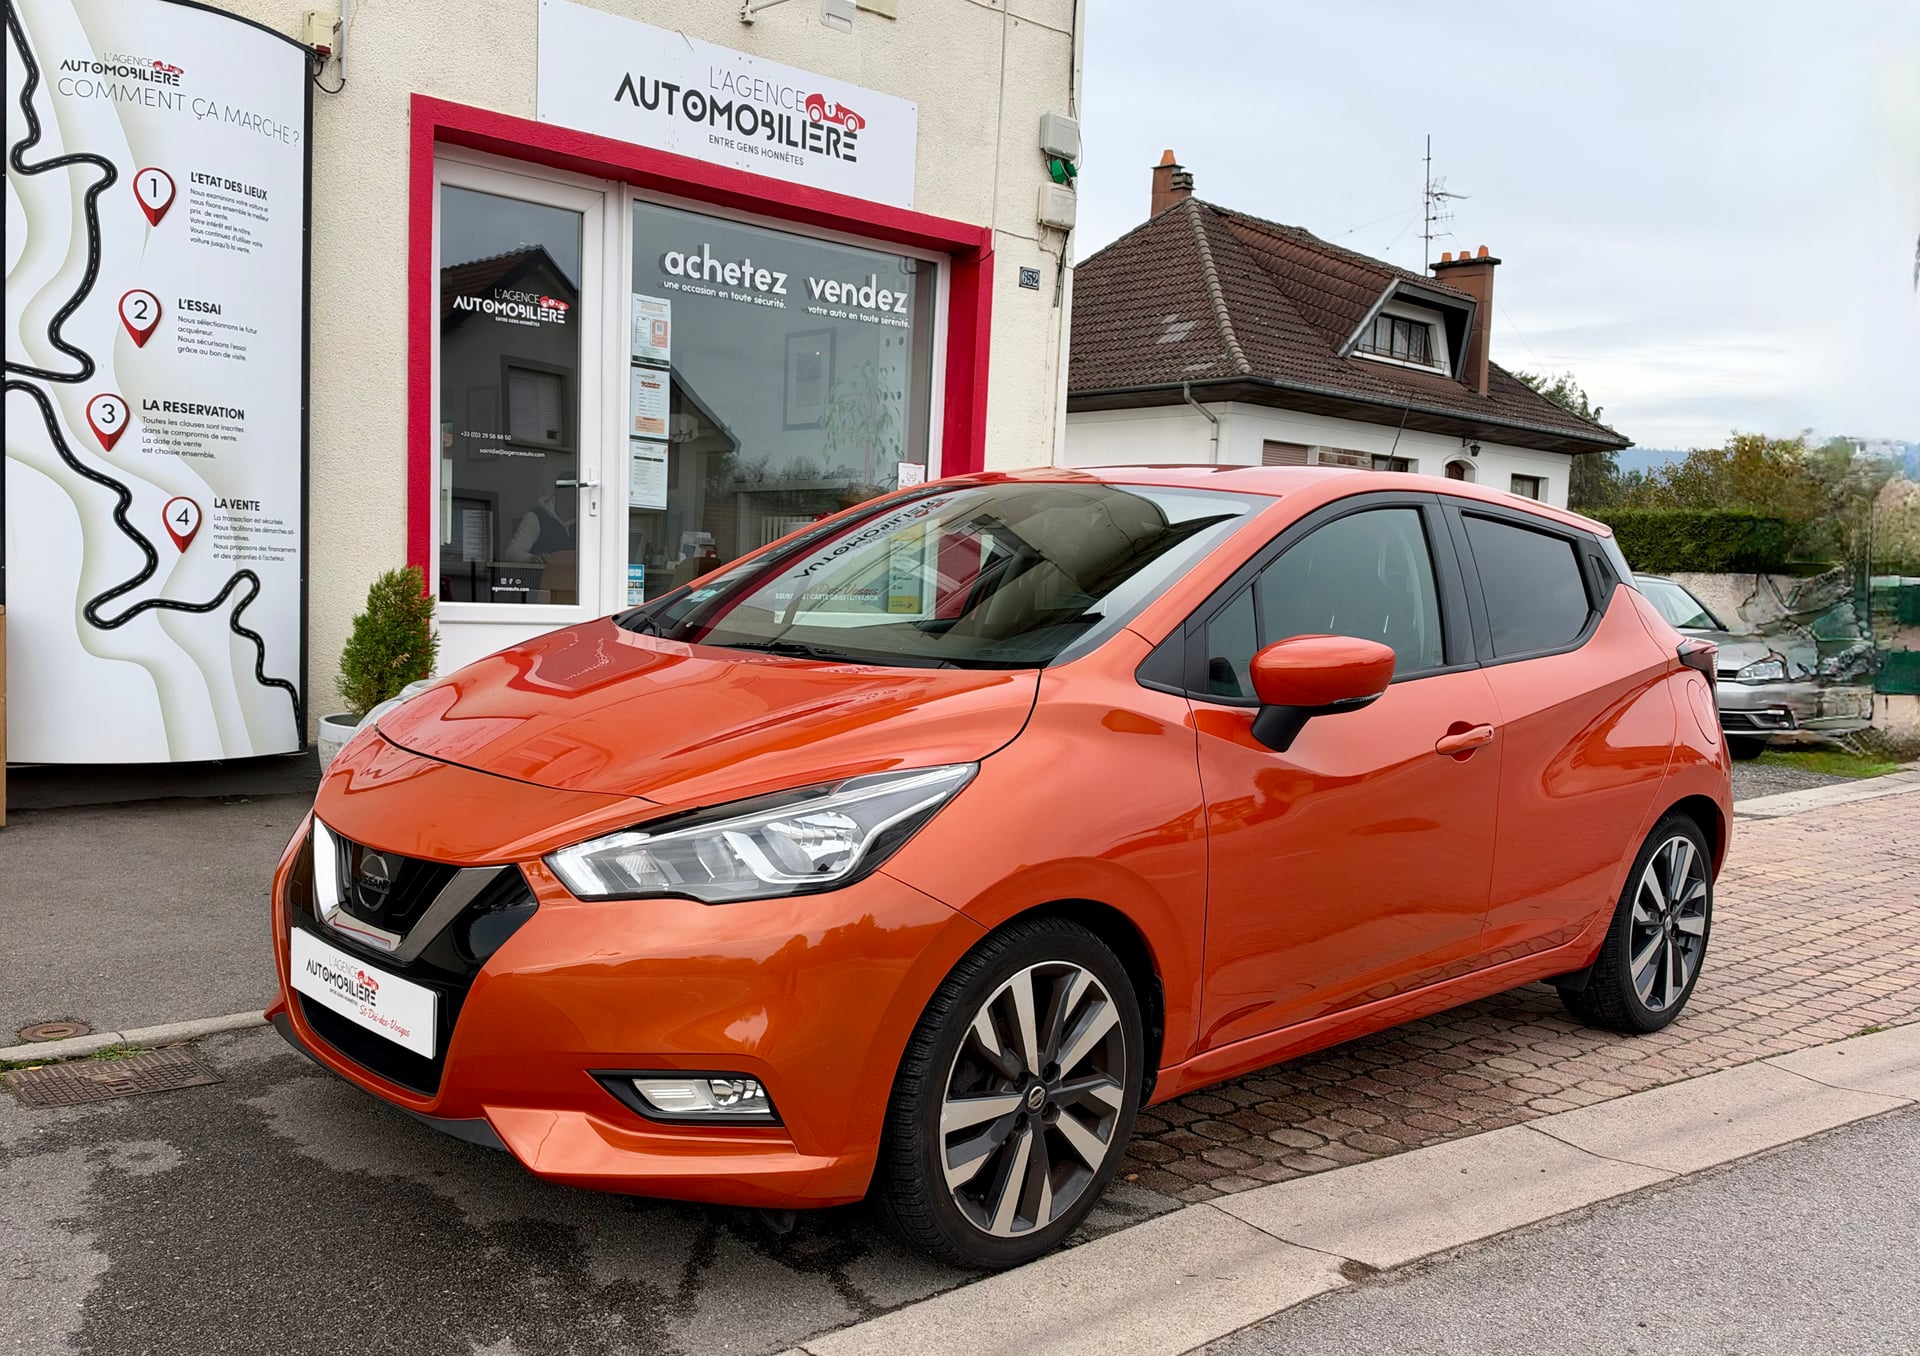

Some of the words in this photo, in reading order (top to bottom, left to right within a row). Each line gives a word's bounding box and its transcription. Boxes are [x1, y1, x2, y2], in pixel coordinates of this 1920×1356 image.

[104, 52, 153, 67] L'AGENCE
[709, 66, 806, 113] L'AGENCE
[58, 78, 186, 111] COMMENT
[192, 98, 218, 120] ÇA
[224, 105, 290, 144] MARCHE
[709, 134, 735, 149] ENTRE
[736, 142, 759, 155] GENS
[761, 148, 804, 166] HONNÊTES
[150, 178, 157, 197] 1
[191, 172, 222, 188] L'ETAT
[224, 179, 242, 193] DES
[244, 184, 268, 200] LIEUX
[190, 188, 205, 197] Nous
[206, 192, 235, 204] examinons
[190, 208, 201, 216] prix
[205, 200, 222, 210] fixons
[190, 217, 205, 225] Votre
[190, 226, 204, 234] Vous
[190, 236, 210, 245] voiture
[664, 243, 789, 295] achetez
[1022, 270, 1038, 286] 652
[494, 288, 540, 304] L'AGENCE
[664, 280, 679, 290] une
[682, 284, 716, 296] occasion
[718, 290, 728, 298] en
[731, 291, 752, 302] toute
[754, 295, 786, 309] sécurité.
[809, 273, 908, 314] vendez
[134, 300, 148, 320] 2
[178, 298, 221, 315] L'ESSAI
[178, 316, 195, 324] Nous
[197, 319, 238, 331] sélectionnons
[808, 306, 828, 315] votre
[829, 309, 847, 318] auto
[860, 314, 879, 323] toute
[881, 316, 910, 328] sérénité.
[178, 335, 195, 344] Nous
[197, 339, 229, 349] sécurisons
[178, 346, 197, 354] grâce
[209, 349, 222, 357] bon
[101, 404, 115, 424] 3
[143, 399, 160, 411] LA
[163, 400, 245, 420] RESERVATION
[142, 416, 166, 425] Toutes
[168, 417, 178, 426] les
[179, 420, 205, 428] clauses
[220, 424, 244, 433] inscrites
[171, 429, 209, 439] compromis
[183, 440, 202, 448] vente
[154, 448, 180, 456] choisie
[181, 449, 216, 459] ensemble.
[214, 498, 228, 509] LA
[229, 499, 260, 511] VENTE
[176, 507, 189, 525] 4
[214, 542, 228, 550] Nous
